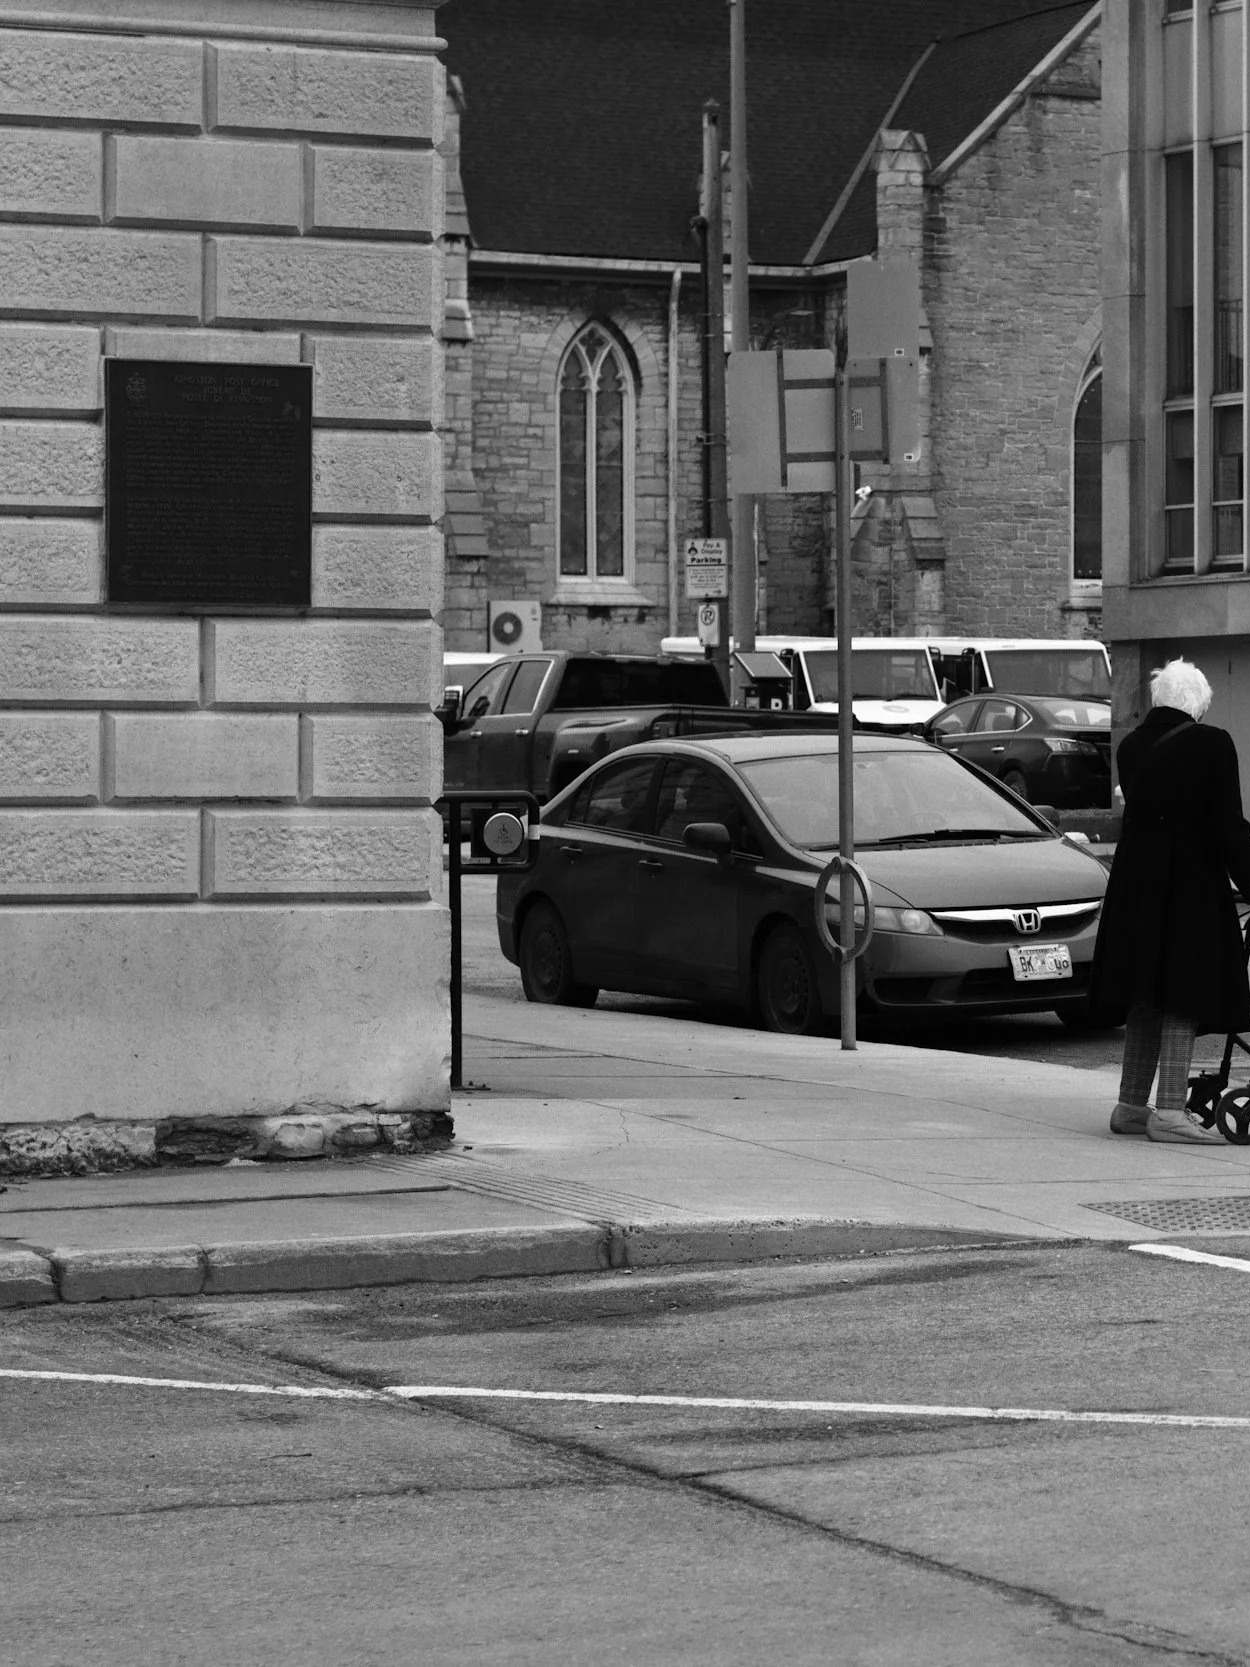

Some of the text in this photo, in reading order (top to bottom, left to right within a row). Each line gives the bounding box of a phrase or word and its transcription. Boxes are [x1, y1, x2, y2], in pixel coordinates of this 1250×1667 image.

[174, 375, 280, 387] KINGSTON POST OFFICE
